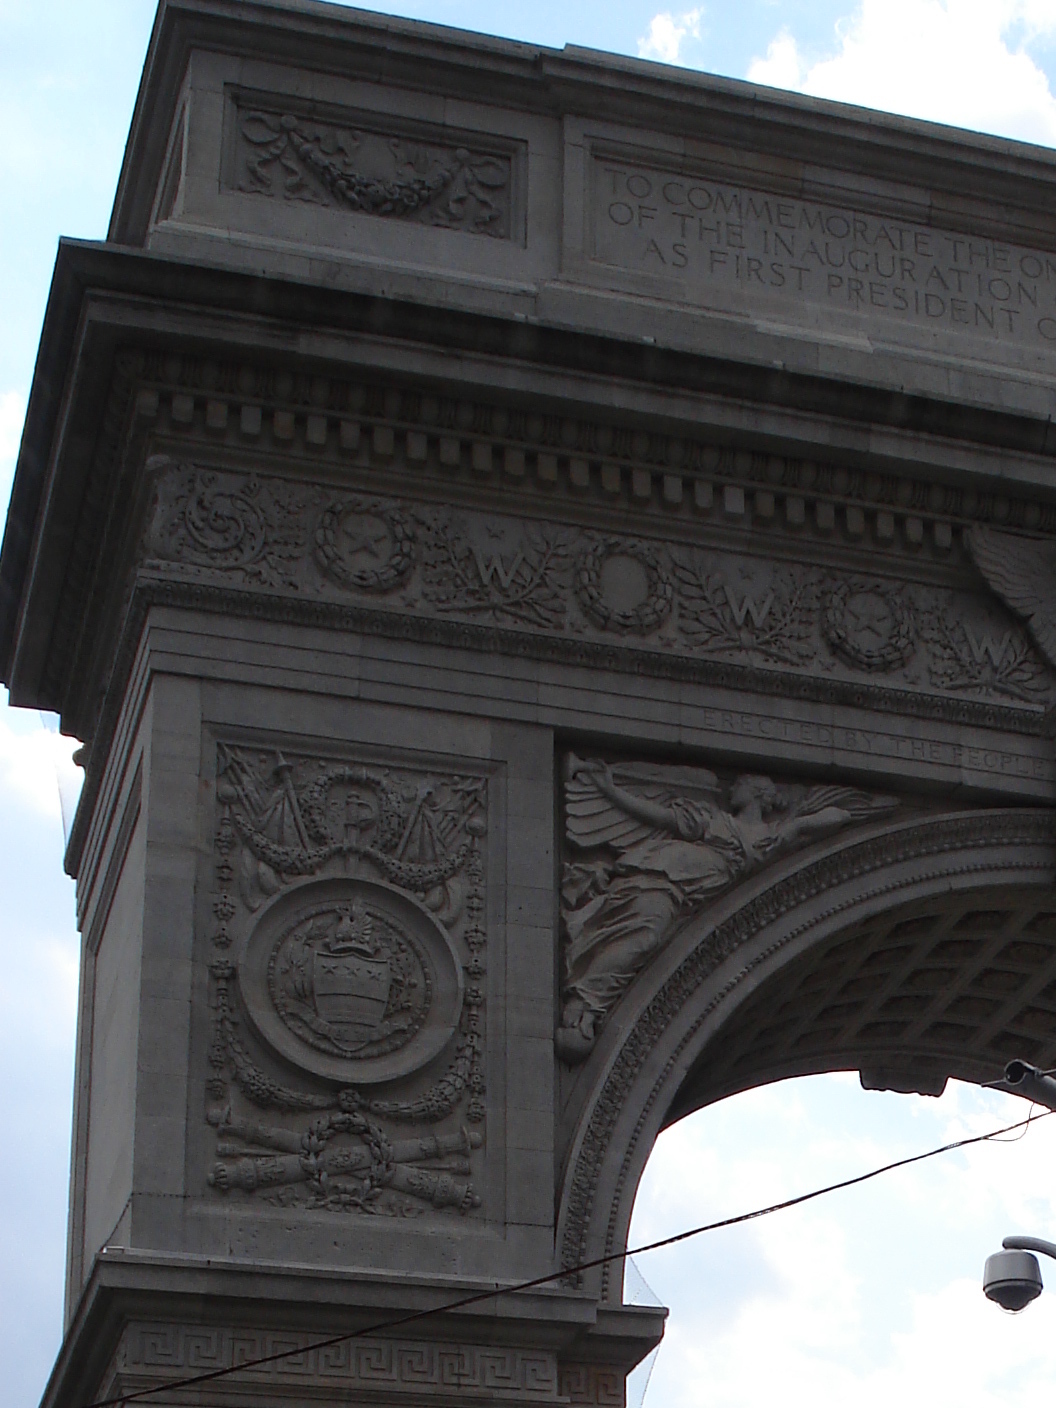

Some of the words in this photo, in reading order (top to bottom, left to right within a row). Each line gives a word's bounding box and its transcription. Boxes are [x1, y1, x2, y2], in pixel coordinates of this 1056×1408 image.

[604, 168, 652, 198] TO
[663, 182, 933, 257] COMMEMORATE
[944, 237, 1011, 273] THE
[608, 202, 657, 228] OF
[672, 212, 745, 249] THE
[764, 230, 1038, 309] INAUGURATION
[643, 239, 688, 268] AS
[710, 250, 811, 291] FIRST
[827, 274, 1020, 332] PRESIDENT
